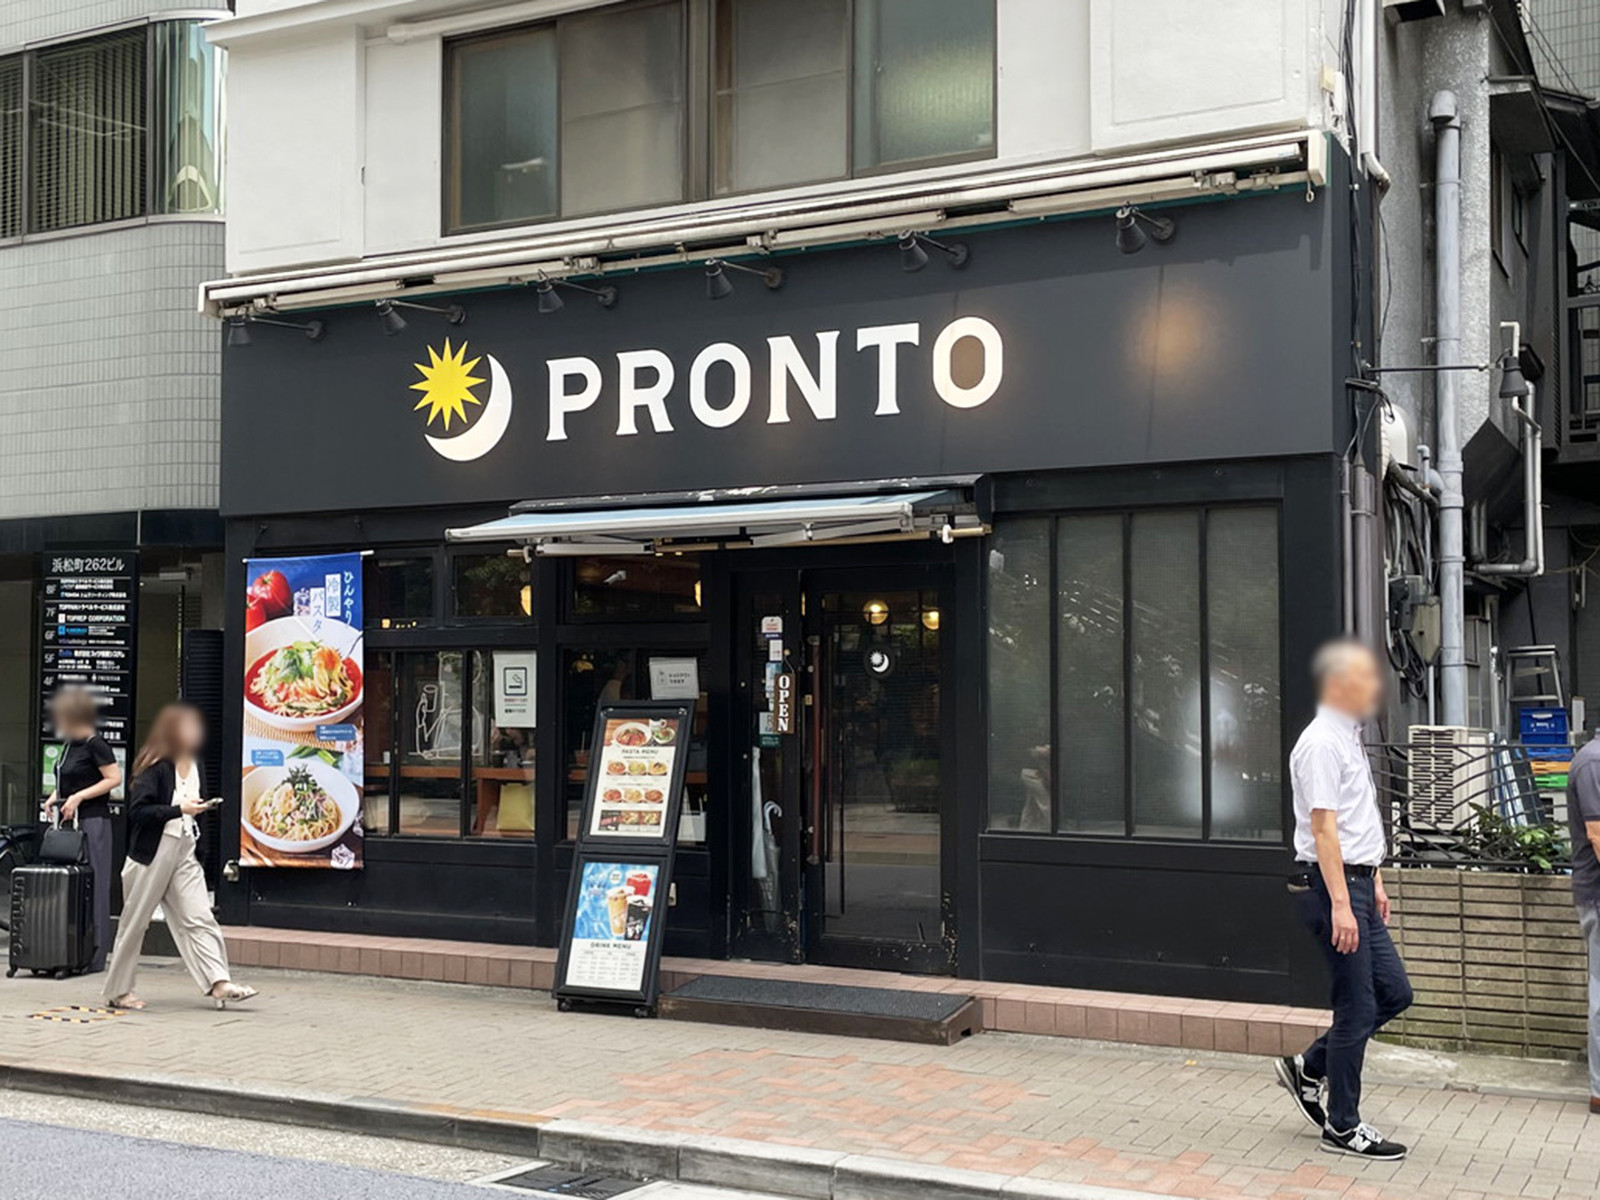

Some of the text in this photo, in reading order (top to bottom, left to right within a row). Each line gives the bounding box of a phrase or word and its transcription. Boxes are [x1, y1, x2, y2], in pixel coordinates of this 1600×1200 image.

[545, 316, 1003, 441] PRONTO
[51, 557, 125, 573] 浜松町262ビル
[343, 571, 355, 627] ひんやり
[46, 607, 56, 617] 7F
[312, 590, 323, 634] パスタ
[44, 630, 56, 640] 6F
[44, 653, 55, 663] 5F
[43, 676, 54, 686] 4F
[778, 675, 790, 732] OPEN
